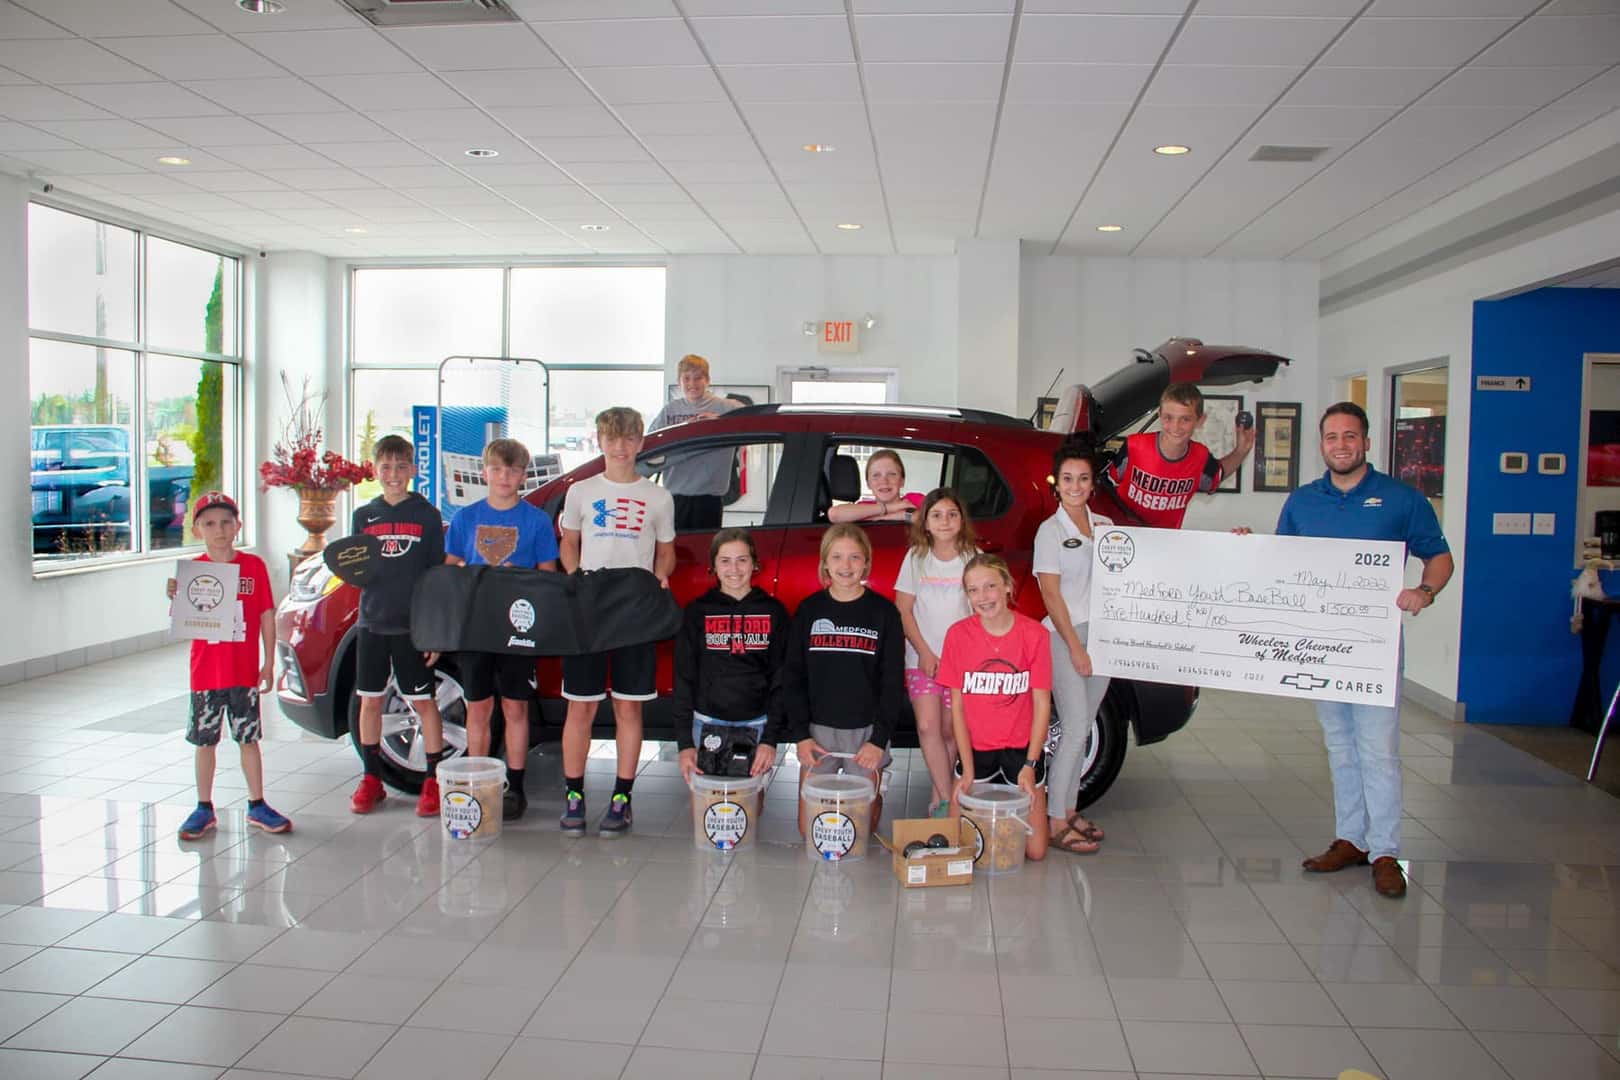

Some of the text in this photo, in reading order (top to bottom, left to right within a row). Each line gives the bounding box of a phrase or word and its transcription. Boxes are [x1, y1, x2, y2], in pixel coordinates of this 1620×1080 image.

[824, 321, 852, 342] EXIT
[1131, 465, 1195, 495] MEDFORD
[207, 493, 225, 505] M
[1127, 484, 1187, 511] BASEBALL
[1354, 552, 1391, 567] 2022
[834, 625, 879, 636] MEDFORD
[811, 634, 877, 651] VOLLEYBALL
[1238, 633, 1353, 654] Wheelers Chevrolet
[1255, 648, 1327, 665] of Medford
[962, 671, 1030, 695] MEDFORD
[1335, 680, 1384, 694] CARES
[707, 823, 743, 831] BASEBALL
[815, 832, 851, 842] BASEBALL
